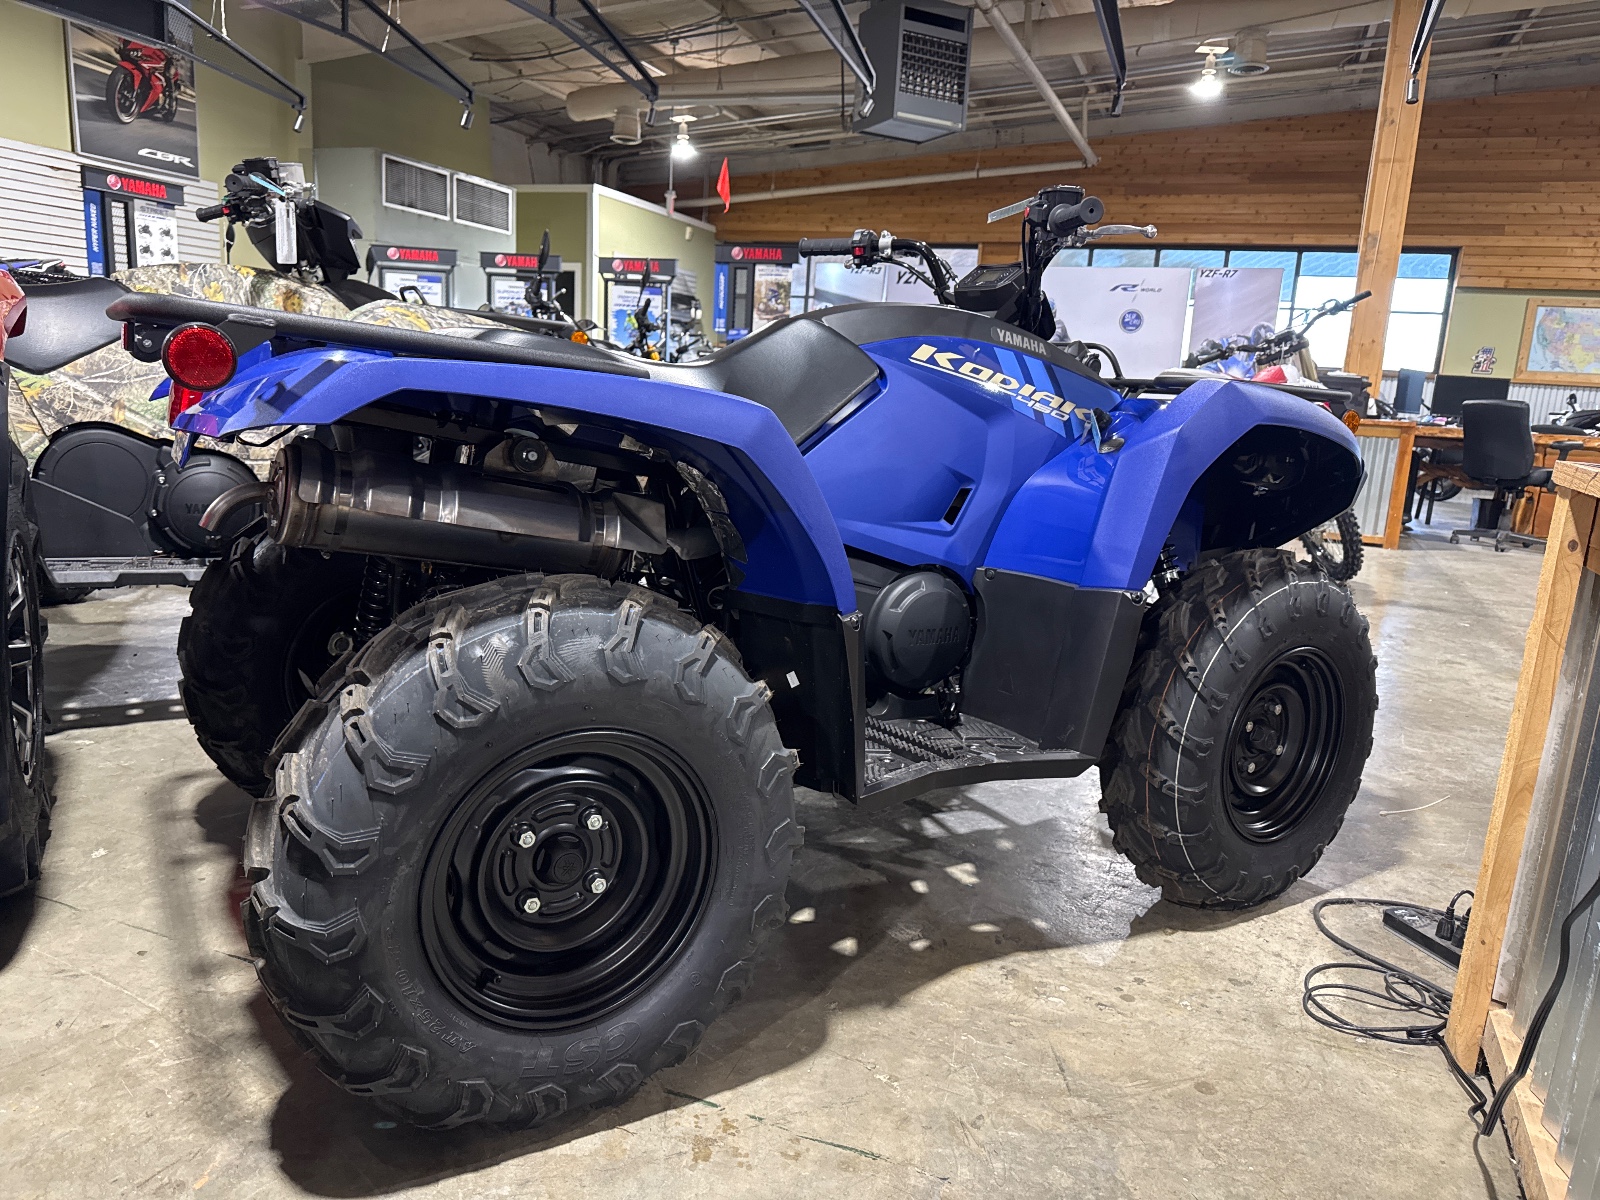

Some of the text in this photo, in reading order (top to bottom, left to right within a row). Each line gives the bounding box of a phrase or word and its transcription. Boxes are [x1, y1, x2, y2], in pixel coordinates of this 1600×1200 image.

[138, 148, 195, 167] CBR
[122, 177, 167, 199] YAMAHA
[399, 248, 439, 262] YAMAHA
[506, 255, 538, 268] YAMAH
[743, 247, 782, 260] YAMAHA
[1200, 269, 1239, 278] YZF-R7
[996, 327, 1047, 355] YAMAHA
[1015, 395, 1070, 421] 450
[184, 503, 209, 514] YAM
[908, 626, 960, 647] YAMAHA
[518, 1020, 641, 1078] CST
